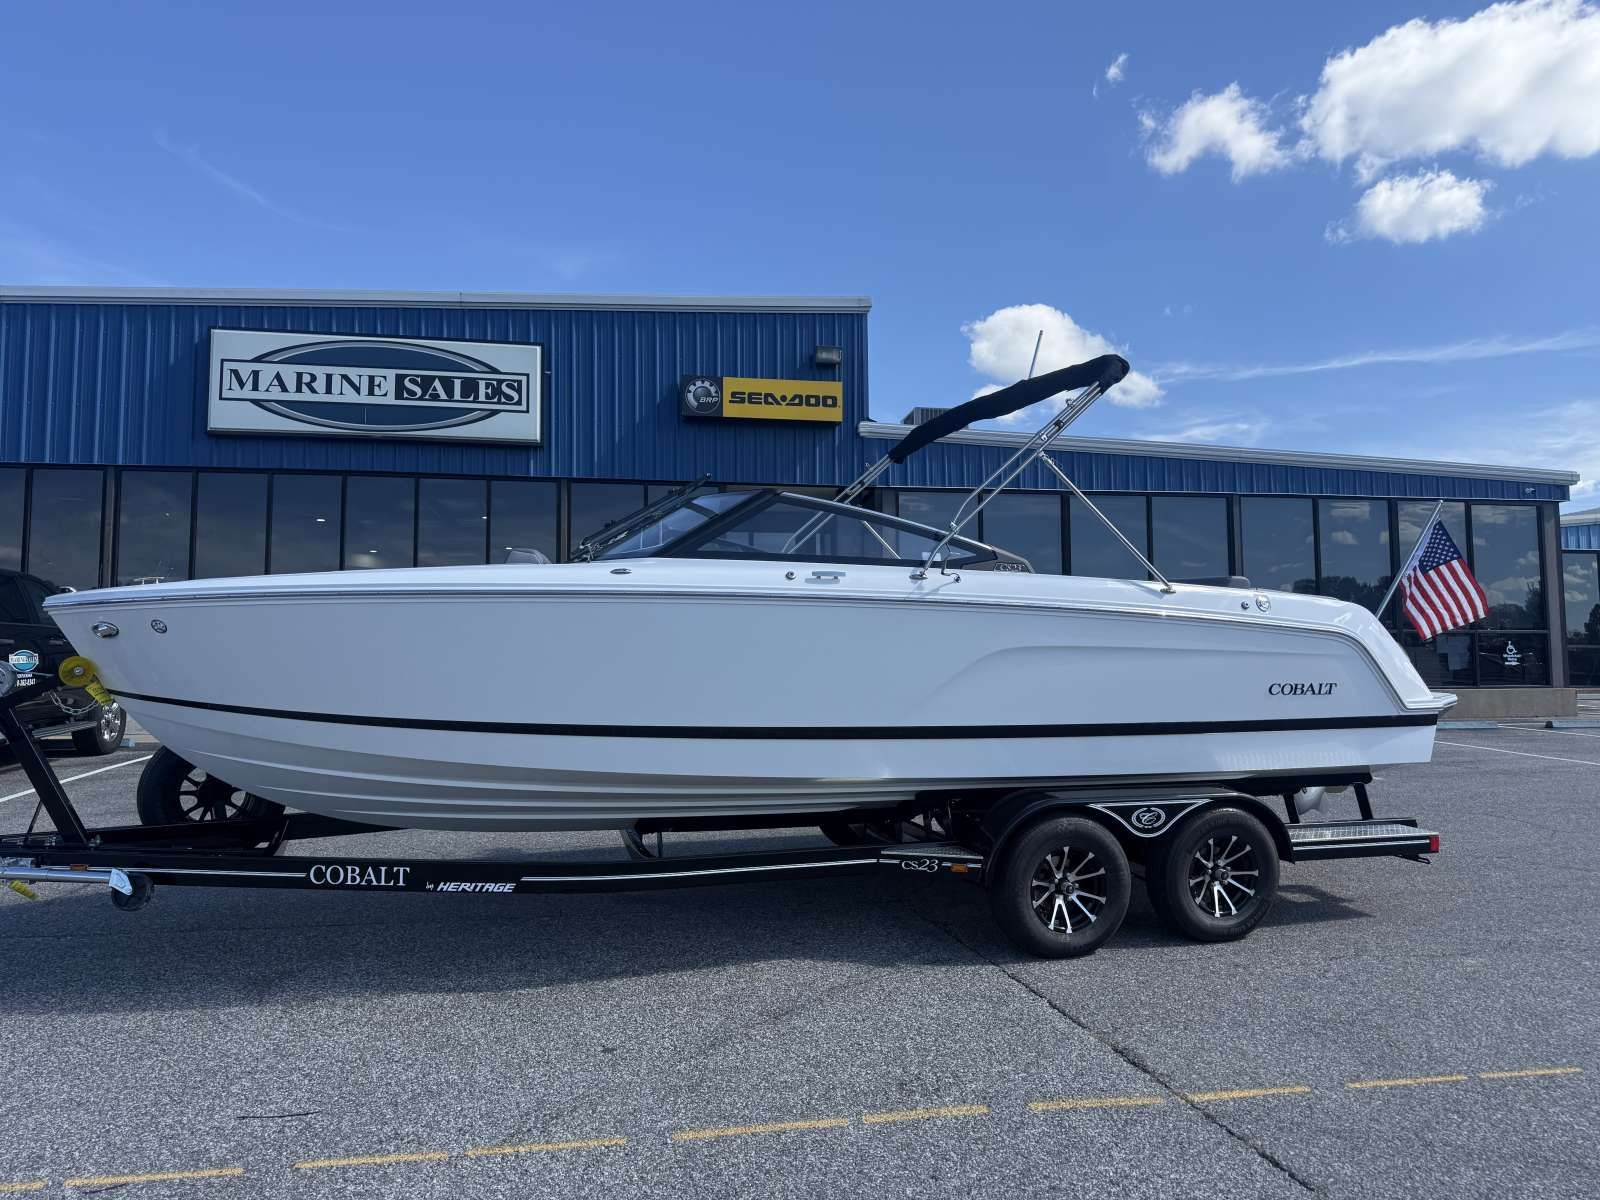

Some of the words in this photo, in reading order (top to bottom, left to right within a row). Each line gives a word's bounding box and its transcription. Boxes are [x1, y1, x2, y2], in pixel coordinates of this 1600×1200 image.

[227, 368, 389, 397] MARINE
[402, 376, 520, 404] SALES
[1268, 682, 1338, 696] COBALT
[309, 864, 410, 887] COBALT
[425, 881, 434, 891] by
[436, 881, 517, 893] HERITAGE
